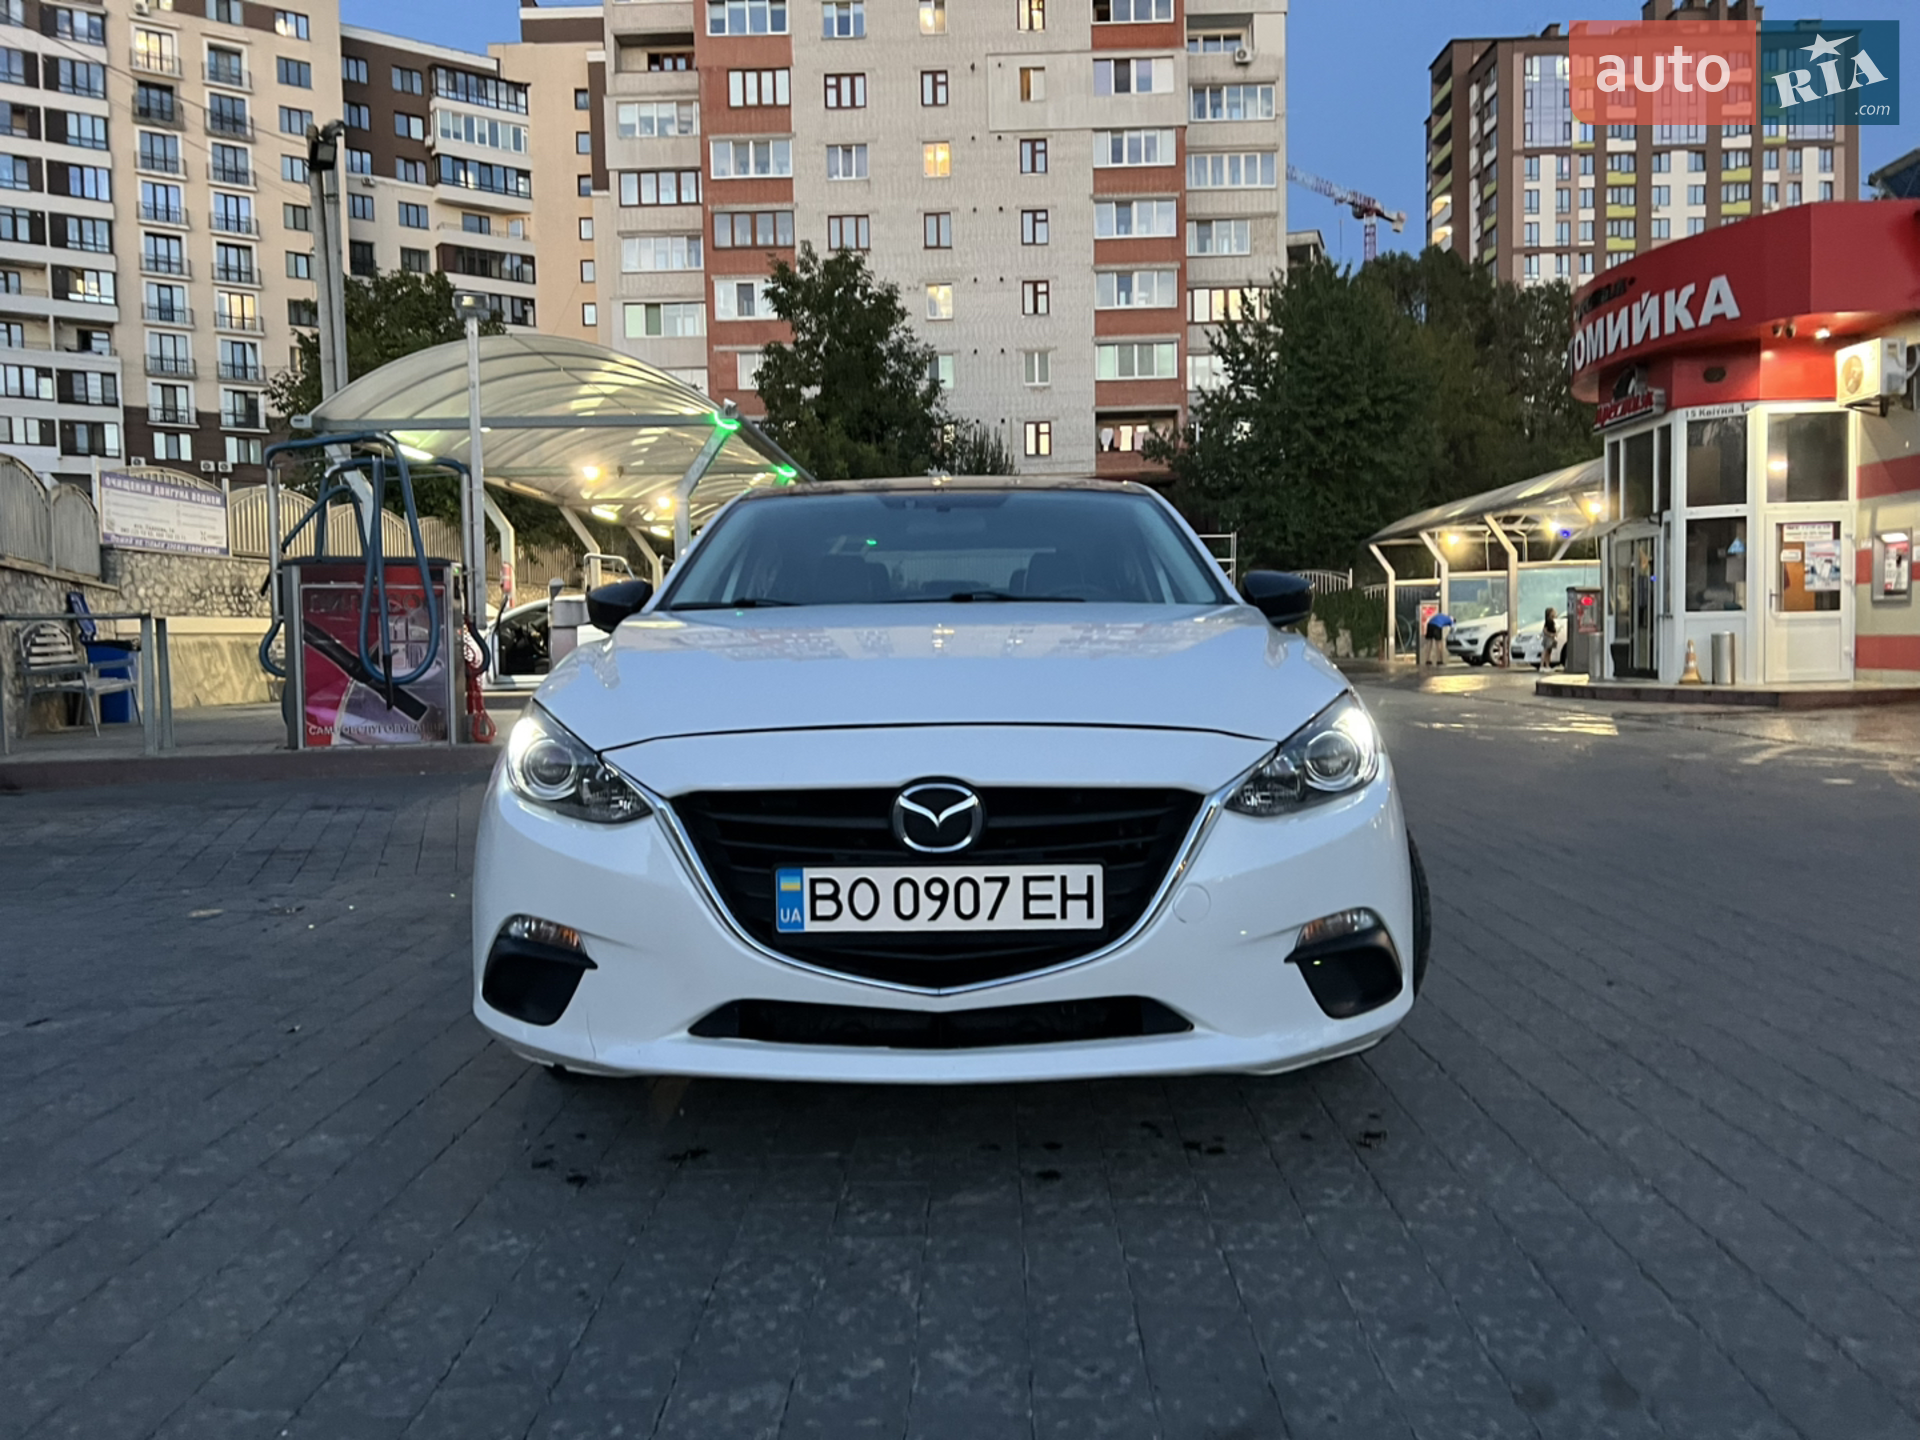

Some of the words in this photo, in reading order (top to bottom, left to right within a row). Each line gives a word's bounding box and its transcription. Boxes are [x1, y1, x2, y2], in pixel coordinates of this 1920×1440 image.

[105, 476, 152, 494] ОЧИЩЕННЯ
[154, 488, 189, 500] ДВИГУНА
[191, 492, 221, 505] ВОДНЕМ
[809, 876, 880, 922] BO
[893, 875, 1010, 922] 0907
[1022, 874, 1095, 921] EH
[780, 907, 802, 924] UA
